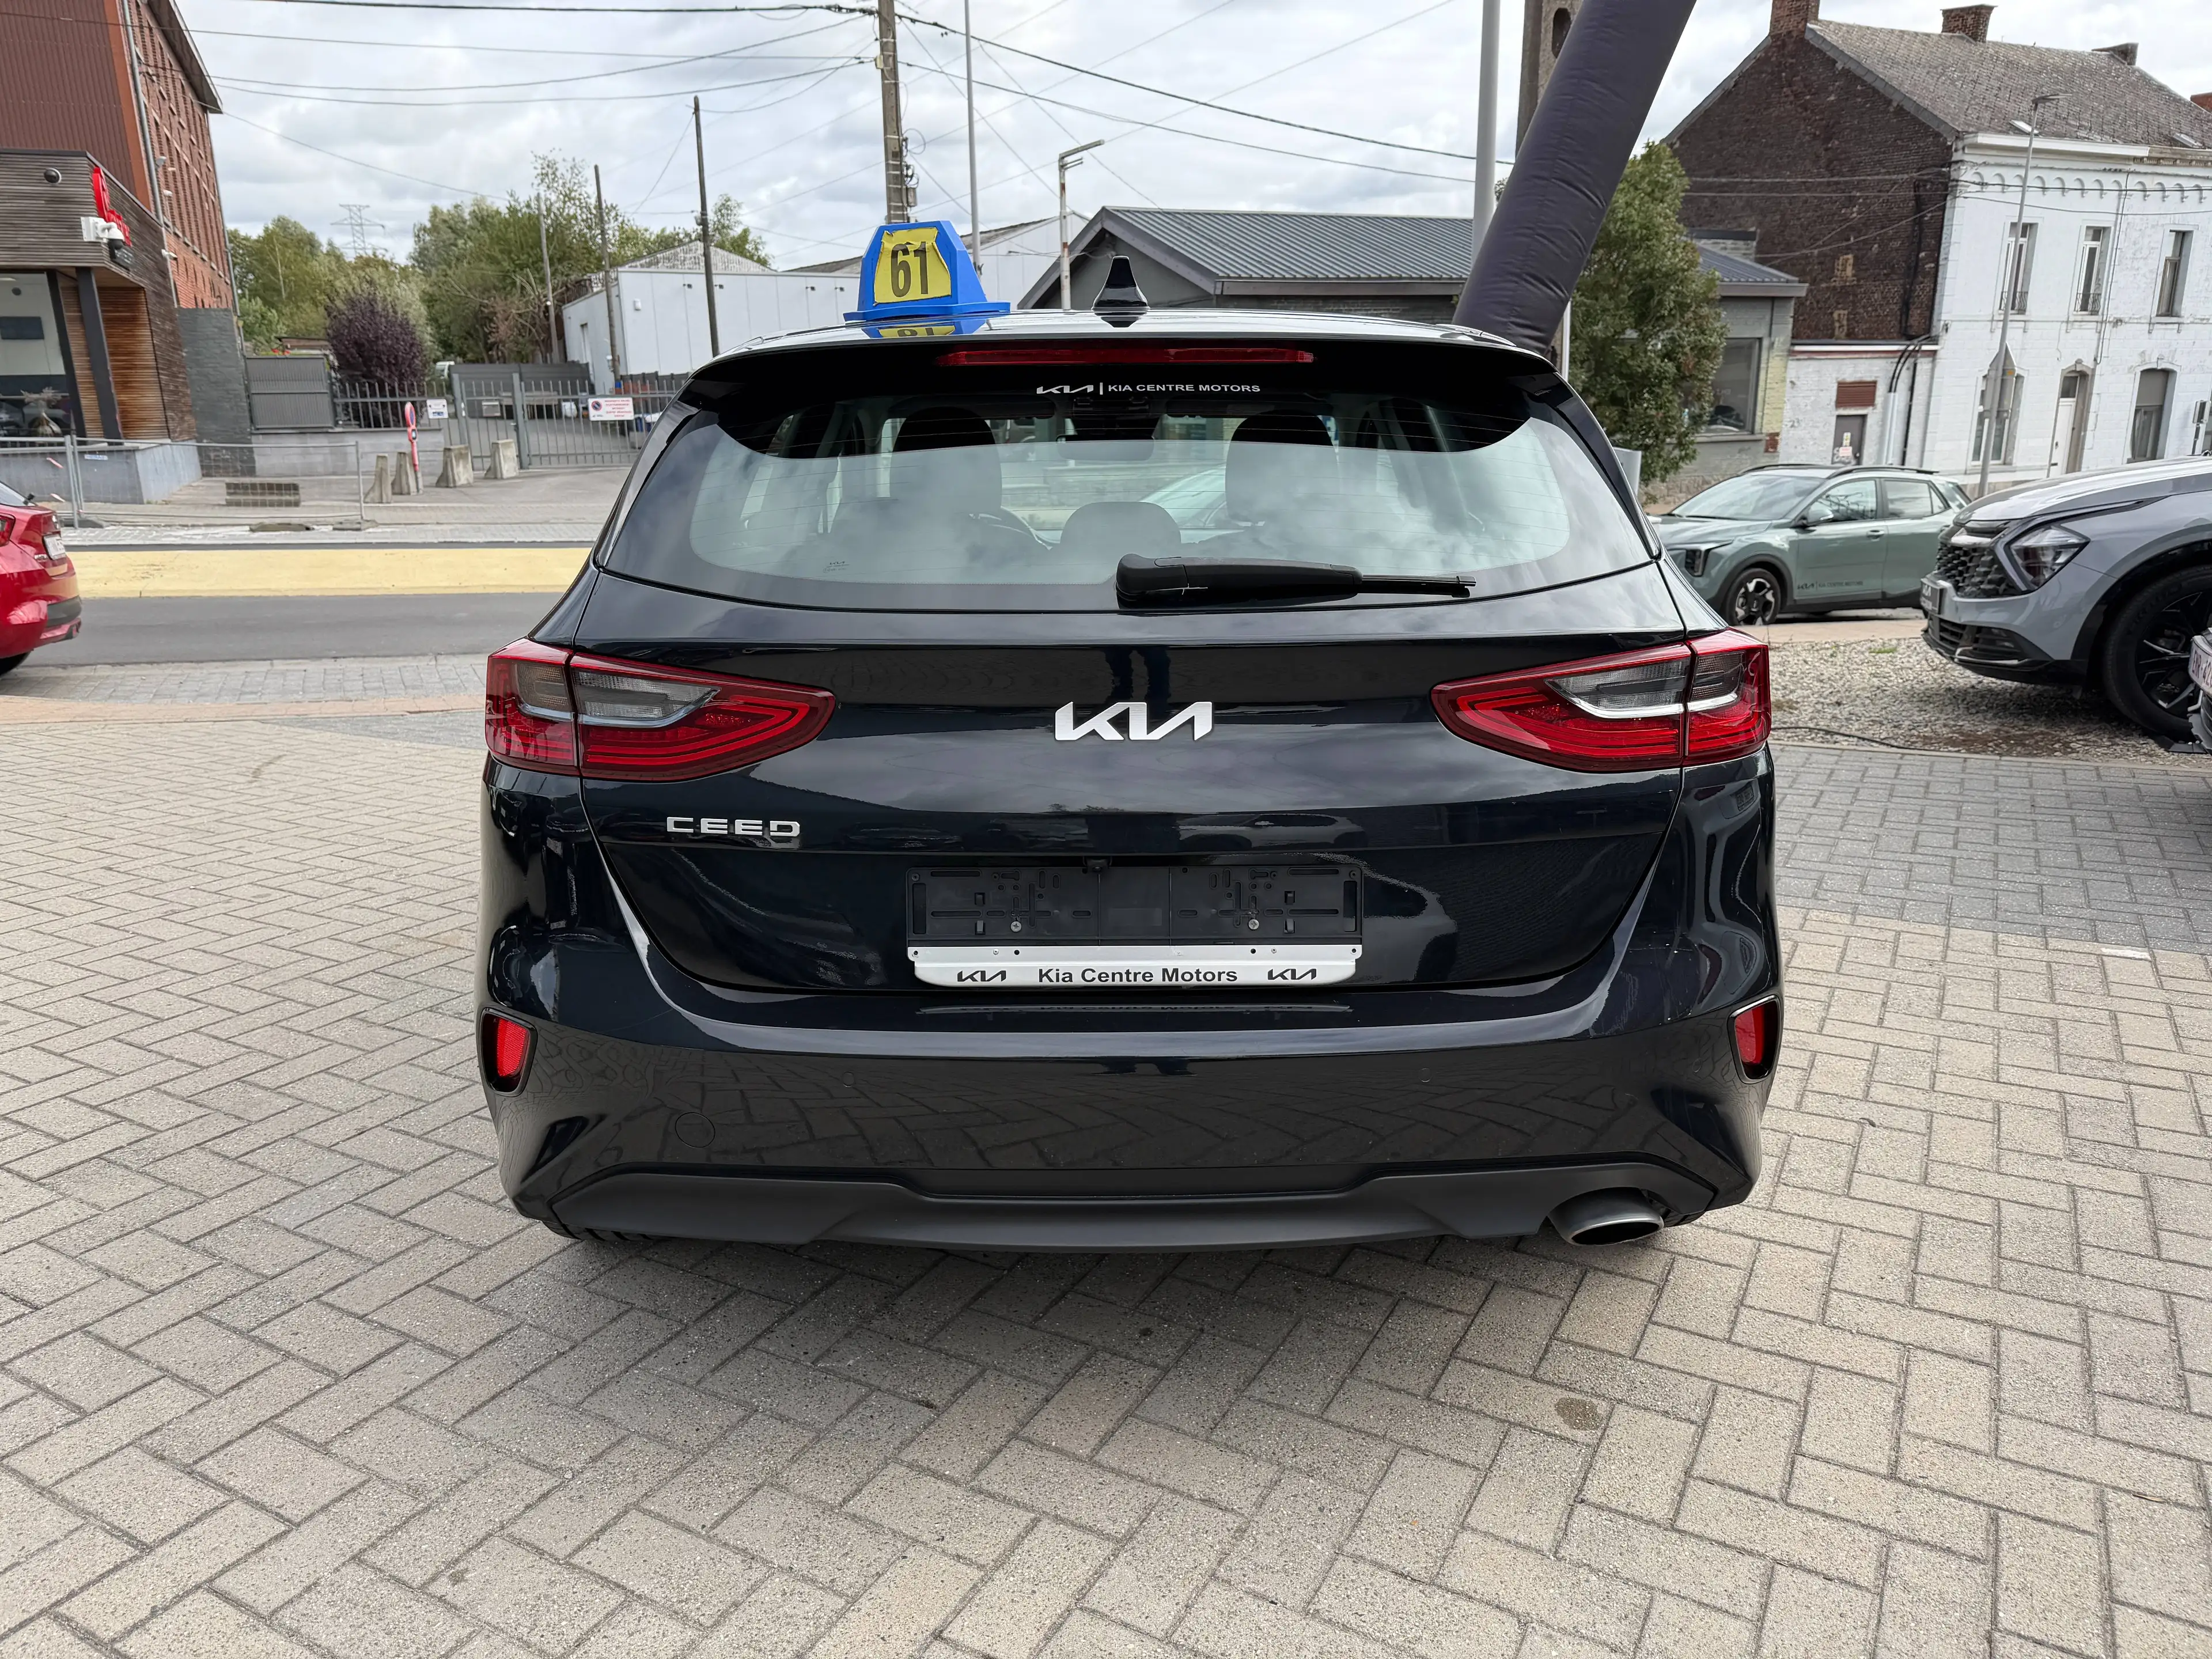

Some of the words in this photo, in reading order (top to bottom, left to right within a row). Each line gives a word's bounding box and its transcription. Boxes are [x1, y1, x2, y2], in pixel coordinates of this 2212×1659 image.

[891, 241, 928, 297] 61
[1037, 385, 1093, 394] KIA
[1055, 701, 1212, 741] KIA
[666, 816, 800, 837] CEED
[957, 970, 1006, 982] KIA
[1039, 968, 1073, 983] Kia
[1081, 968, 1153, 983] Centre
[1161, 968, 1238, 982] Motors
[1267, 968, 1317, 980] KIA
